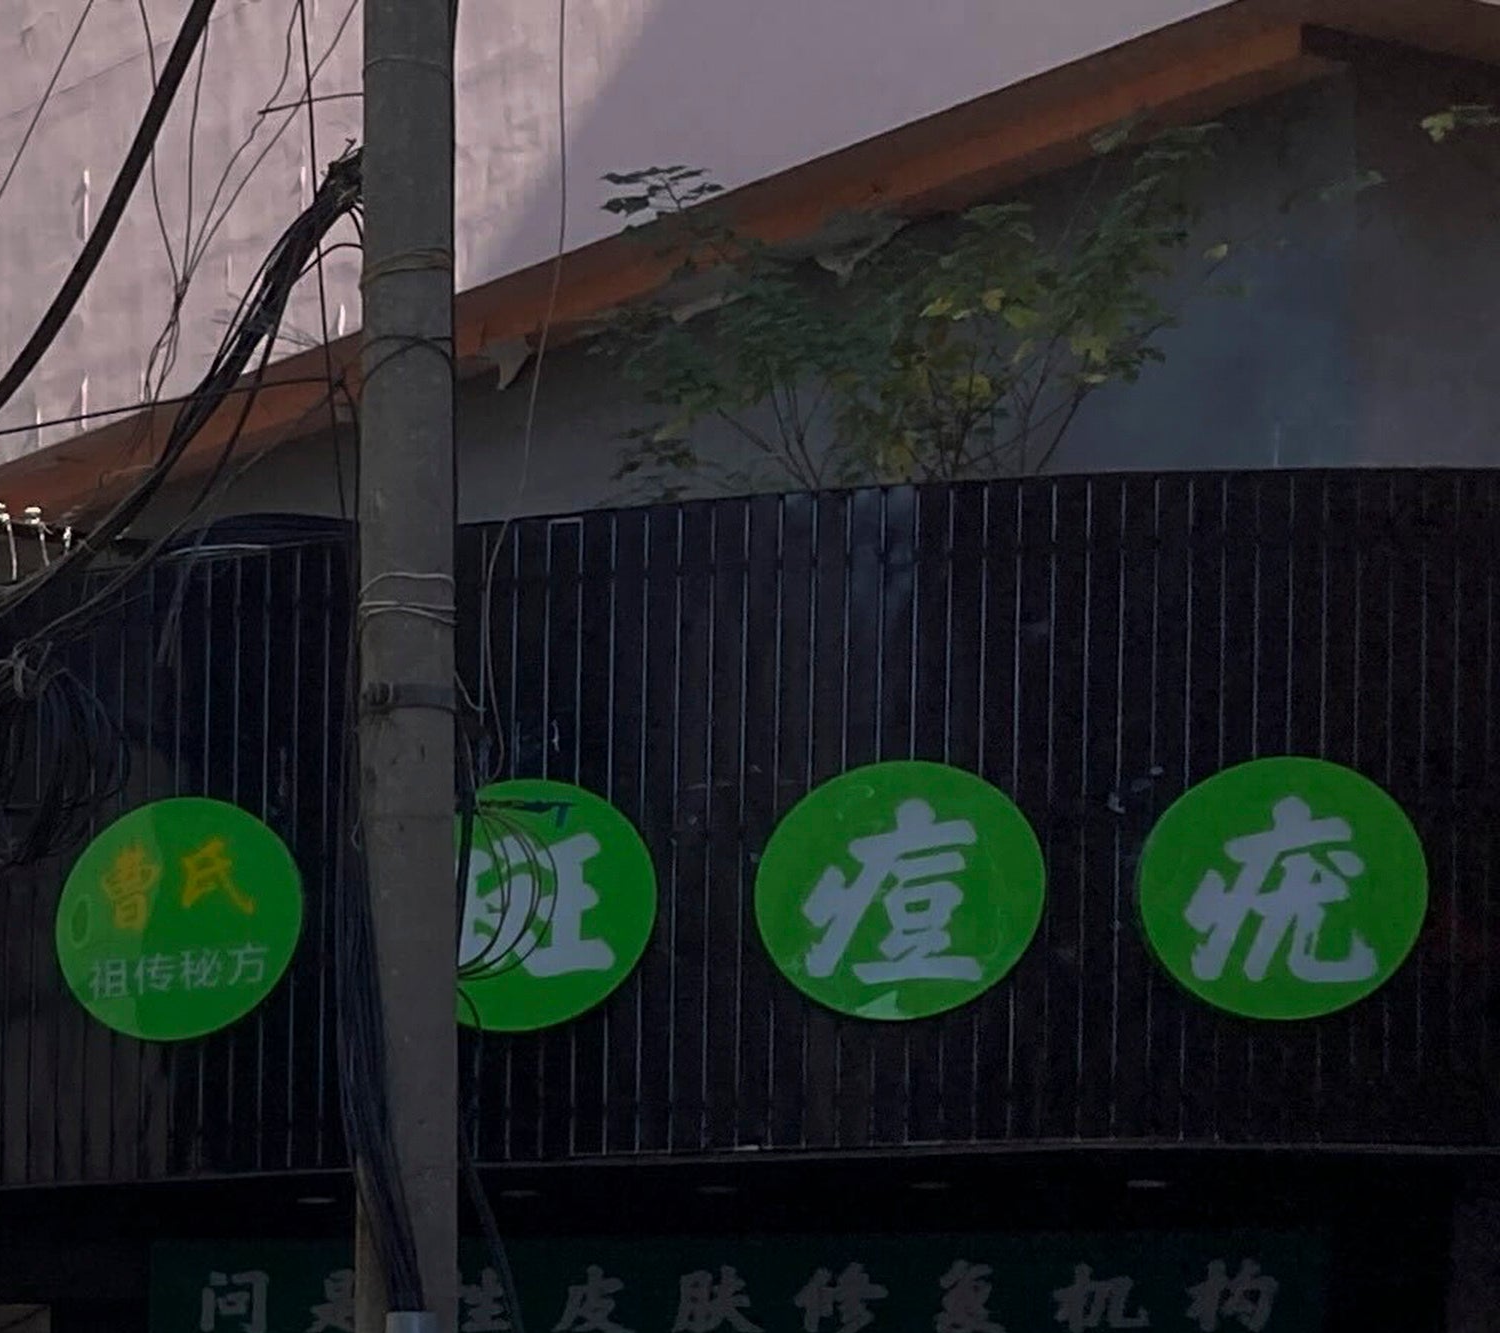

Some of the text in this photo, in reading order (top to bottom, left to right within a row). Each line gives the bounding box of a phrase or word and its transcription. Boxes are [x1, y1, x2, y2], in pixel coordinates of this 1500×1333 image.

[103, 836, 257, 933] 曹氏
[802, 797, 985, 984] 痘
[88, 942, 271, 1000] 祖传秘方
